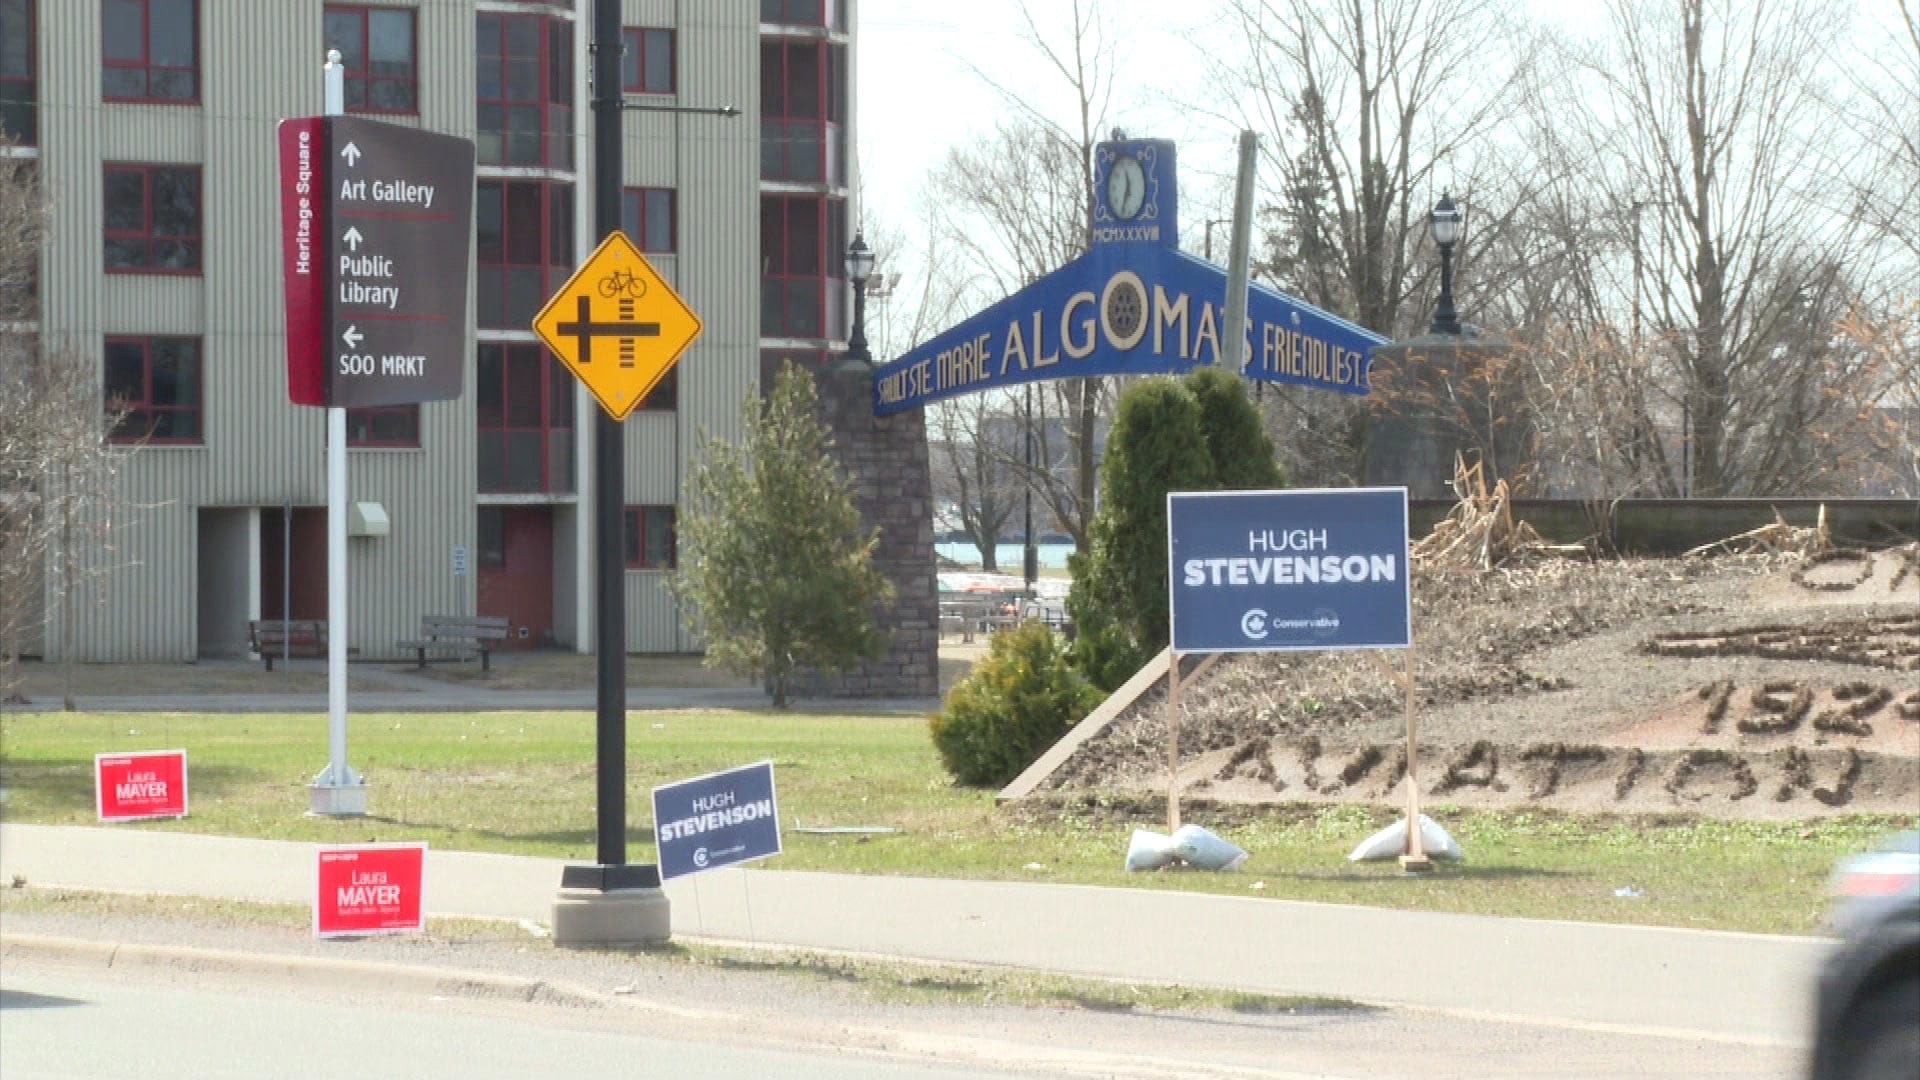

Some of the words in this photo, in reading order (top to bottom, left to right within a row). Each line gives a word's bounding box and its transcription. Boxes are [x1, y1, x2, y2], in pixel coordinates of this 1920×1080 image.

[295, 131, 313, 195] Square
[340, 179, 367, 201] Art
[372, 180, 434, 208] Gallery
[295, 197, 313, 274] Heritage
[340, 255, 393, 278] Public
[340, 281, 399, 309] Library
[339, 355, 375, 376] SOO
[381, 355, 427, 377] MRKT
[936, 332, 992, 391] MARIE
[1263, 321, 1363, 387] FRIENDLIEST
[1248, 527, 1328, 552] HUGH
[1183, 553, 1397, 587] STEVENSON
[1272, 616, 1341, 630] Conservative
[115, 781, 168, 800] MAYER
[692, 791, 735, 813] HUGH
[660, 799, 772, 843] STEVENSON
[351, 869, 388, 885] Laura
[337, 885, 401, 908] MAYER
